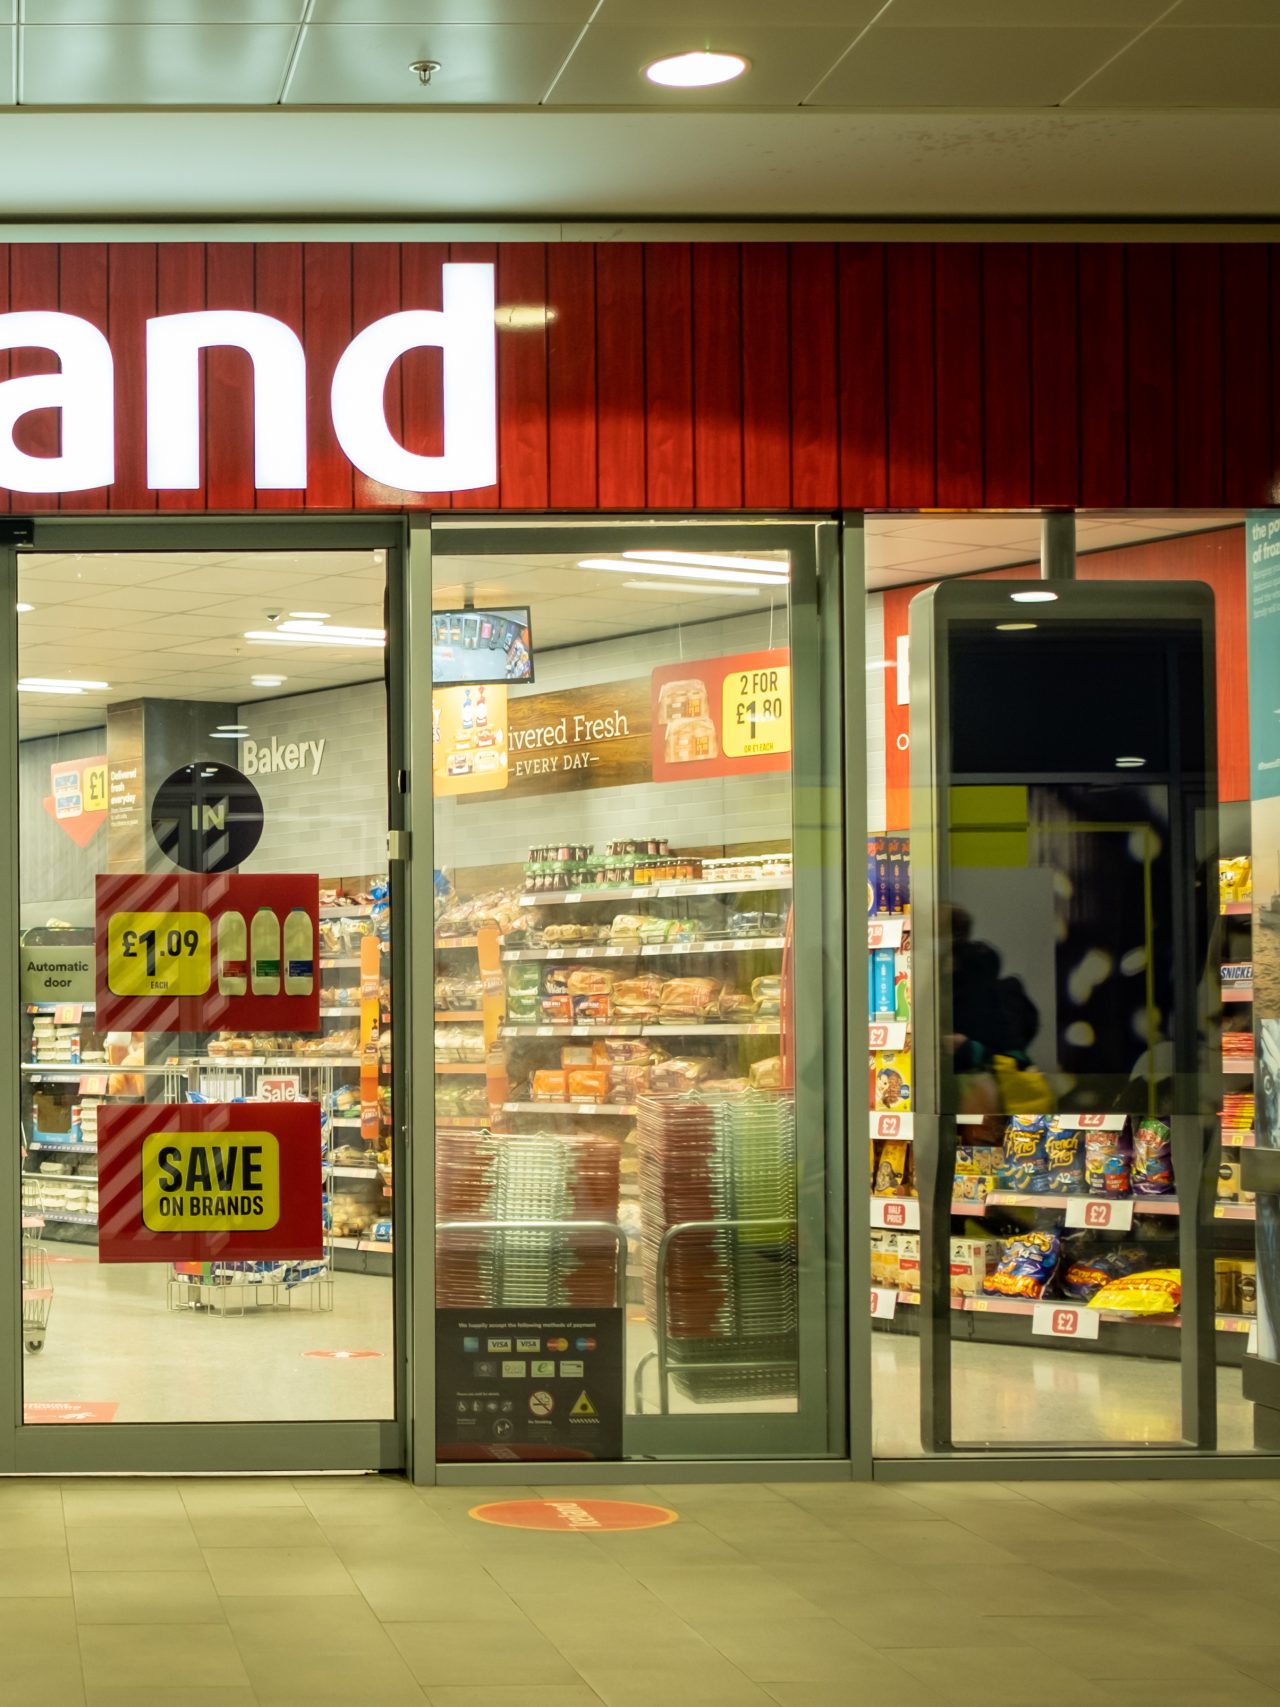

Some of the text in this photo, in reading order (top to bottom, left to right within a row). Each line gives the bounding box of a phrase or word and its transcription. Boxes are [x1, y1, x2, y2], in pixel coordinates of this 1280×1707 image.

[740, 671, 778, 695] 2 FOR
[573, 710, 629, 742] Fresh
[243, 735, 326, 776] Bakery
[516, 752, 590, 776] EVERY DAY
[192, 804, 225, 831] IN
[122, 930, 200, 977] £1.09
[27, 961, 89, 973] Automatic
[1221, 966, 1253, 979] SNICKE
[43, 977, 72, 988] door
[150, 981, 169, 990] EACH
[262, 1081, 295, 1101] Sale
[881, 1118, 897, 1136] £2
[157, 1145, 263, 1192] SAVE
[159, 1195, 264, 1216] ON BRANDS
[1089, 1205, 1107, 1223] £2
[1056, 1313, 1073, 1331] £2
